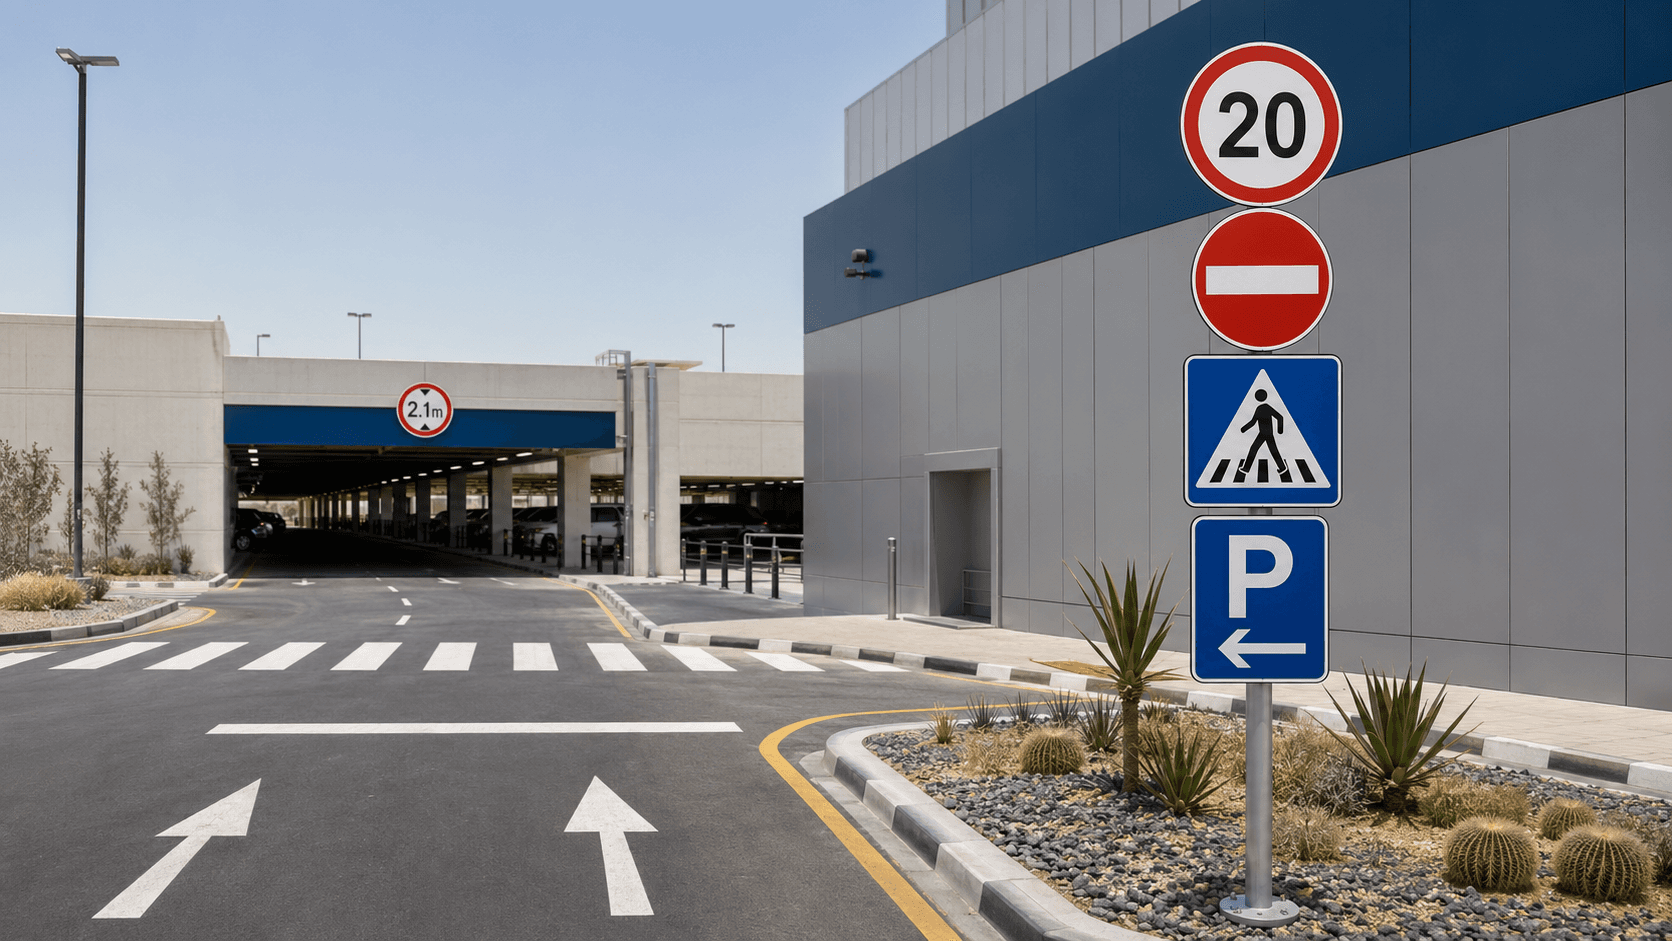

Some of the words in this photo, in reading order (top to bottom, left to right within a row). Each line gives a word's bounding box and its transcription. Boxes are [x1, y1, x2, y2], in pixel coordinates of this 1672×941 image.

[1218, 91, 1306, 159] 20
[407, 401, 443, 418] 2.1m
[1228, 534, 1294, 618] P
